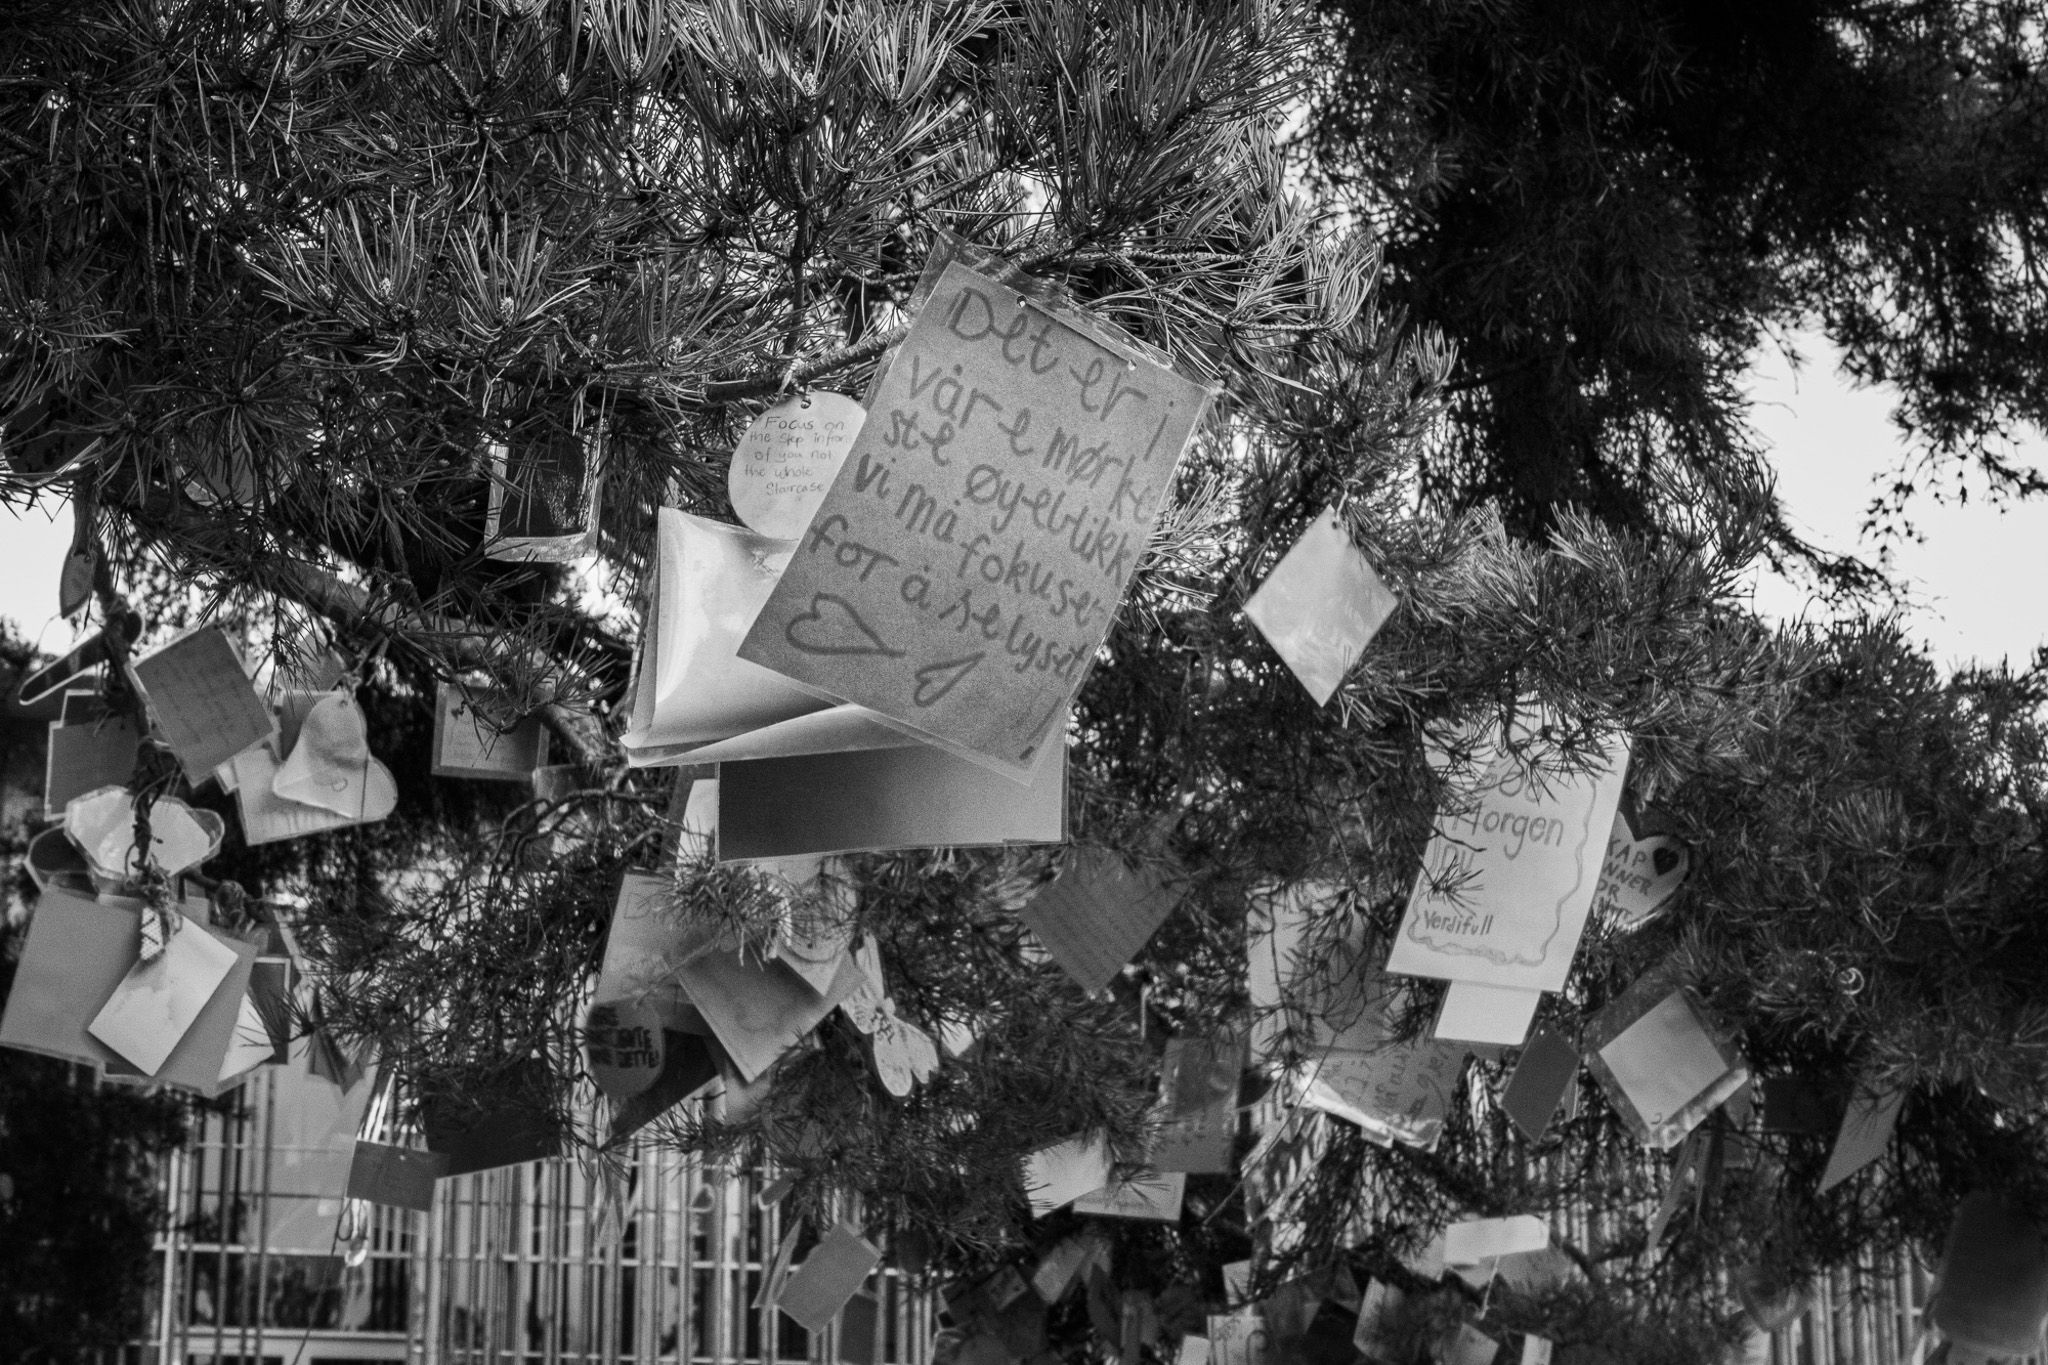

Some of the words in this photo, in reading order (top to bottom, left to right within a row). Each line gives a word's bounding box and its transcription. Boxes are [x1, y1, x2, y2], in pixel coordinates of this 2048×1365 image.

[946, 286, 1059, 375] Det
[1068, 357, 1148, 422] er
[764, 416, 814, 430] Focus
[824, 421, 845, 434] on
[750, 431, 771, 444] the
[754, 447, 771, 462] of
[775, 450, 802, 463] you
[745, 463, 766, 476] the
[895, 483, 961, 544] må
[809, 513, 900, 583] for
[901, 564, 932, 611] å
[937, 588, 1000, 641] se
